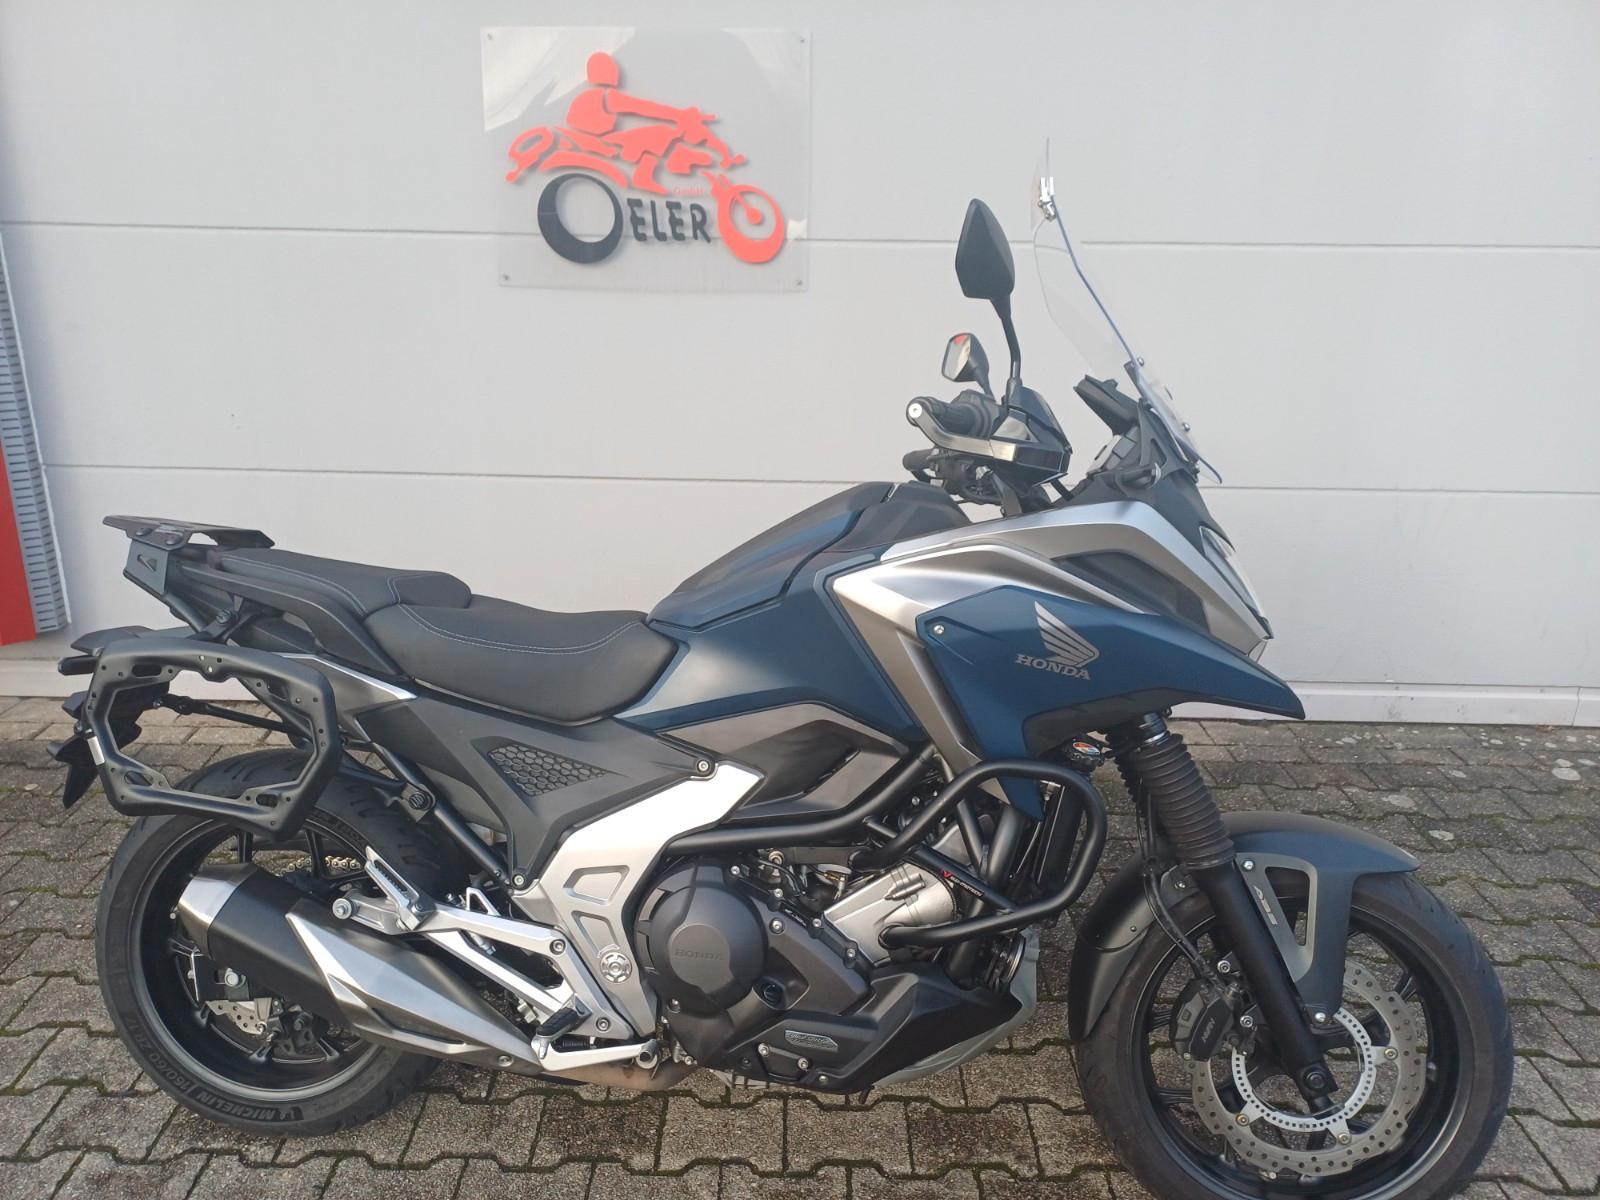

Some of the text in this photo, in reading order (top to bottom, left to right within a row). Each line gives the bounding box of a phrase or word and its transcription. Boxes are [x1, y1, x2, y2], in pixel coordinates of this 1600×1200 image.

[1014, 653, 1091, 680] HONDA
[148, 1052, 191, 1091] 160/60
[195, 1090, 277, 1120] MICHELIN
